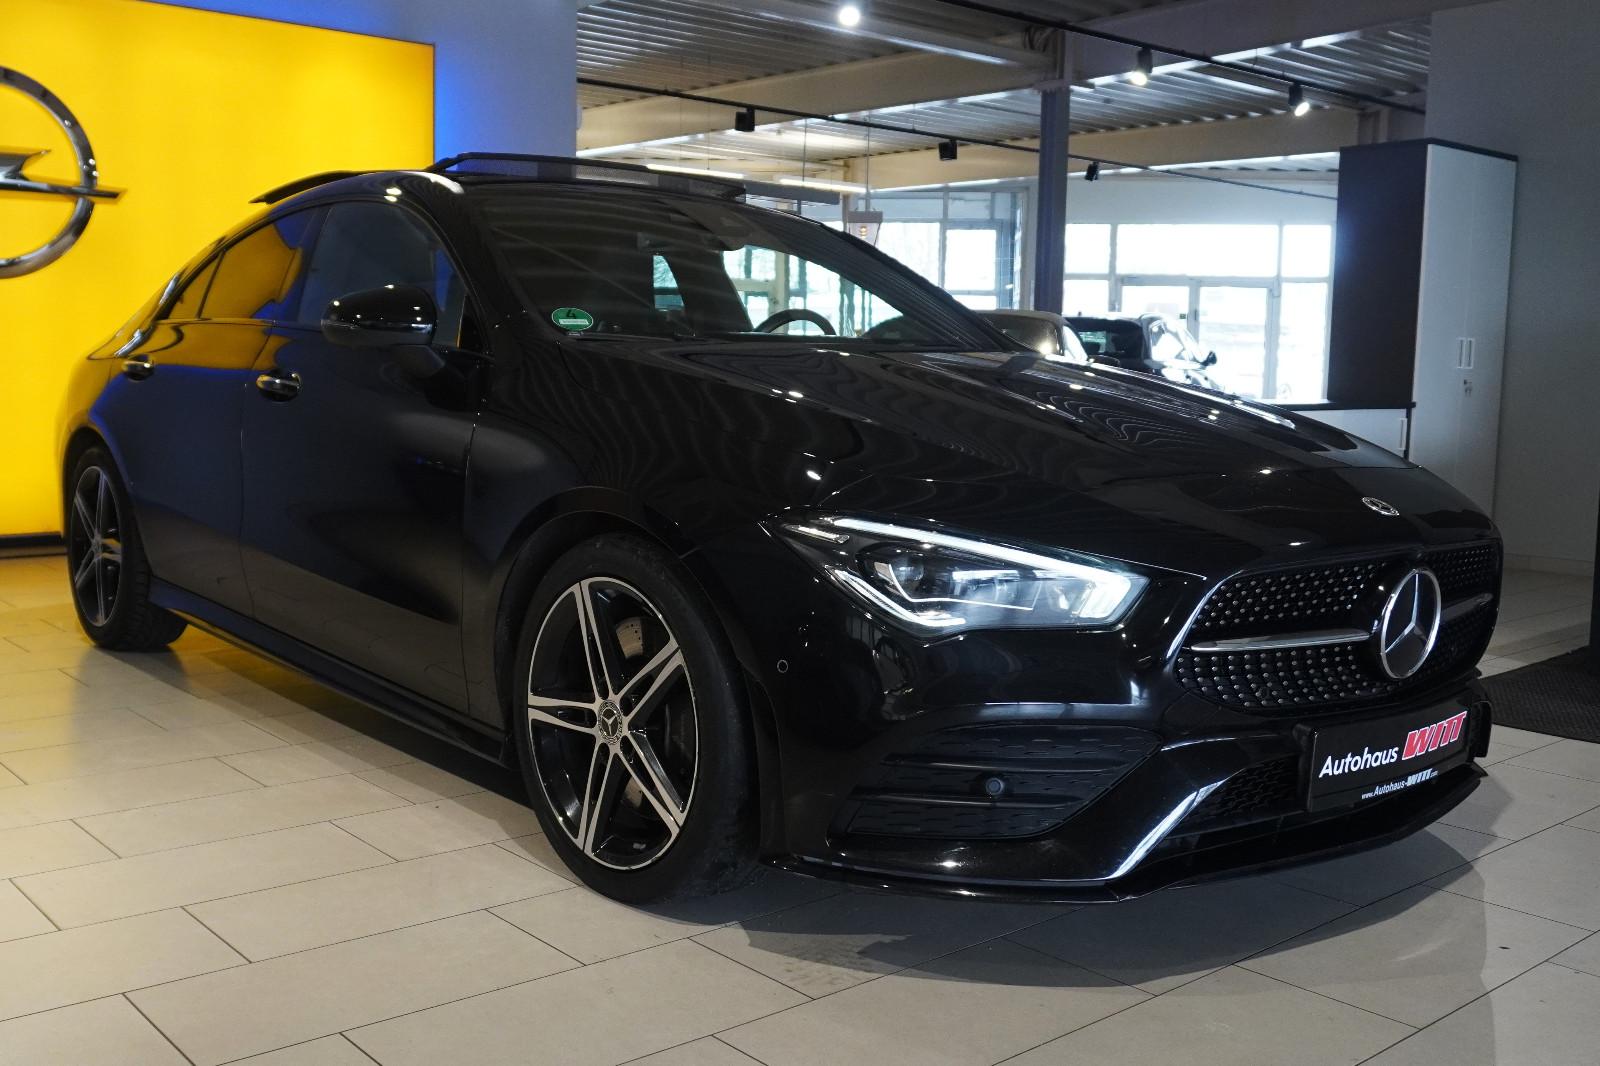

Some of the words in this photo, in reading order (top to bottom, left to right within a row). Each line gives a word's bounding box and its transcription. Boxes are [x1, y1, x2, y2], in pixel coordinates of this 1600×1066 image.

[566, 309, 577, 319] 4
[1318, 747, 1399, 778] Autohaus
[1401, 710, 1468, 761] WITT
[1361, 768, 1439, 799] www.Autohaus-WITT.com
